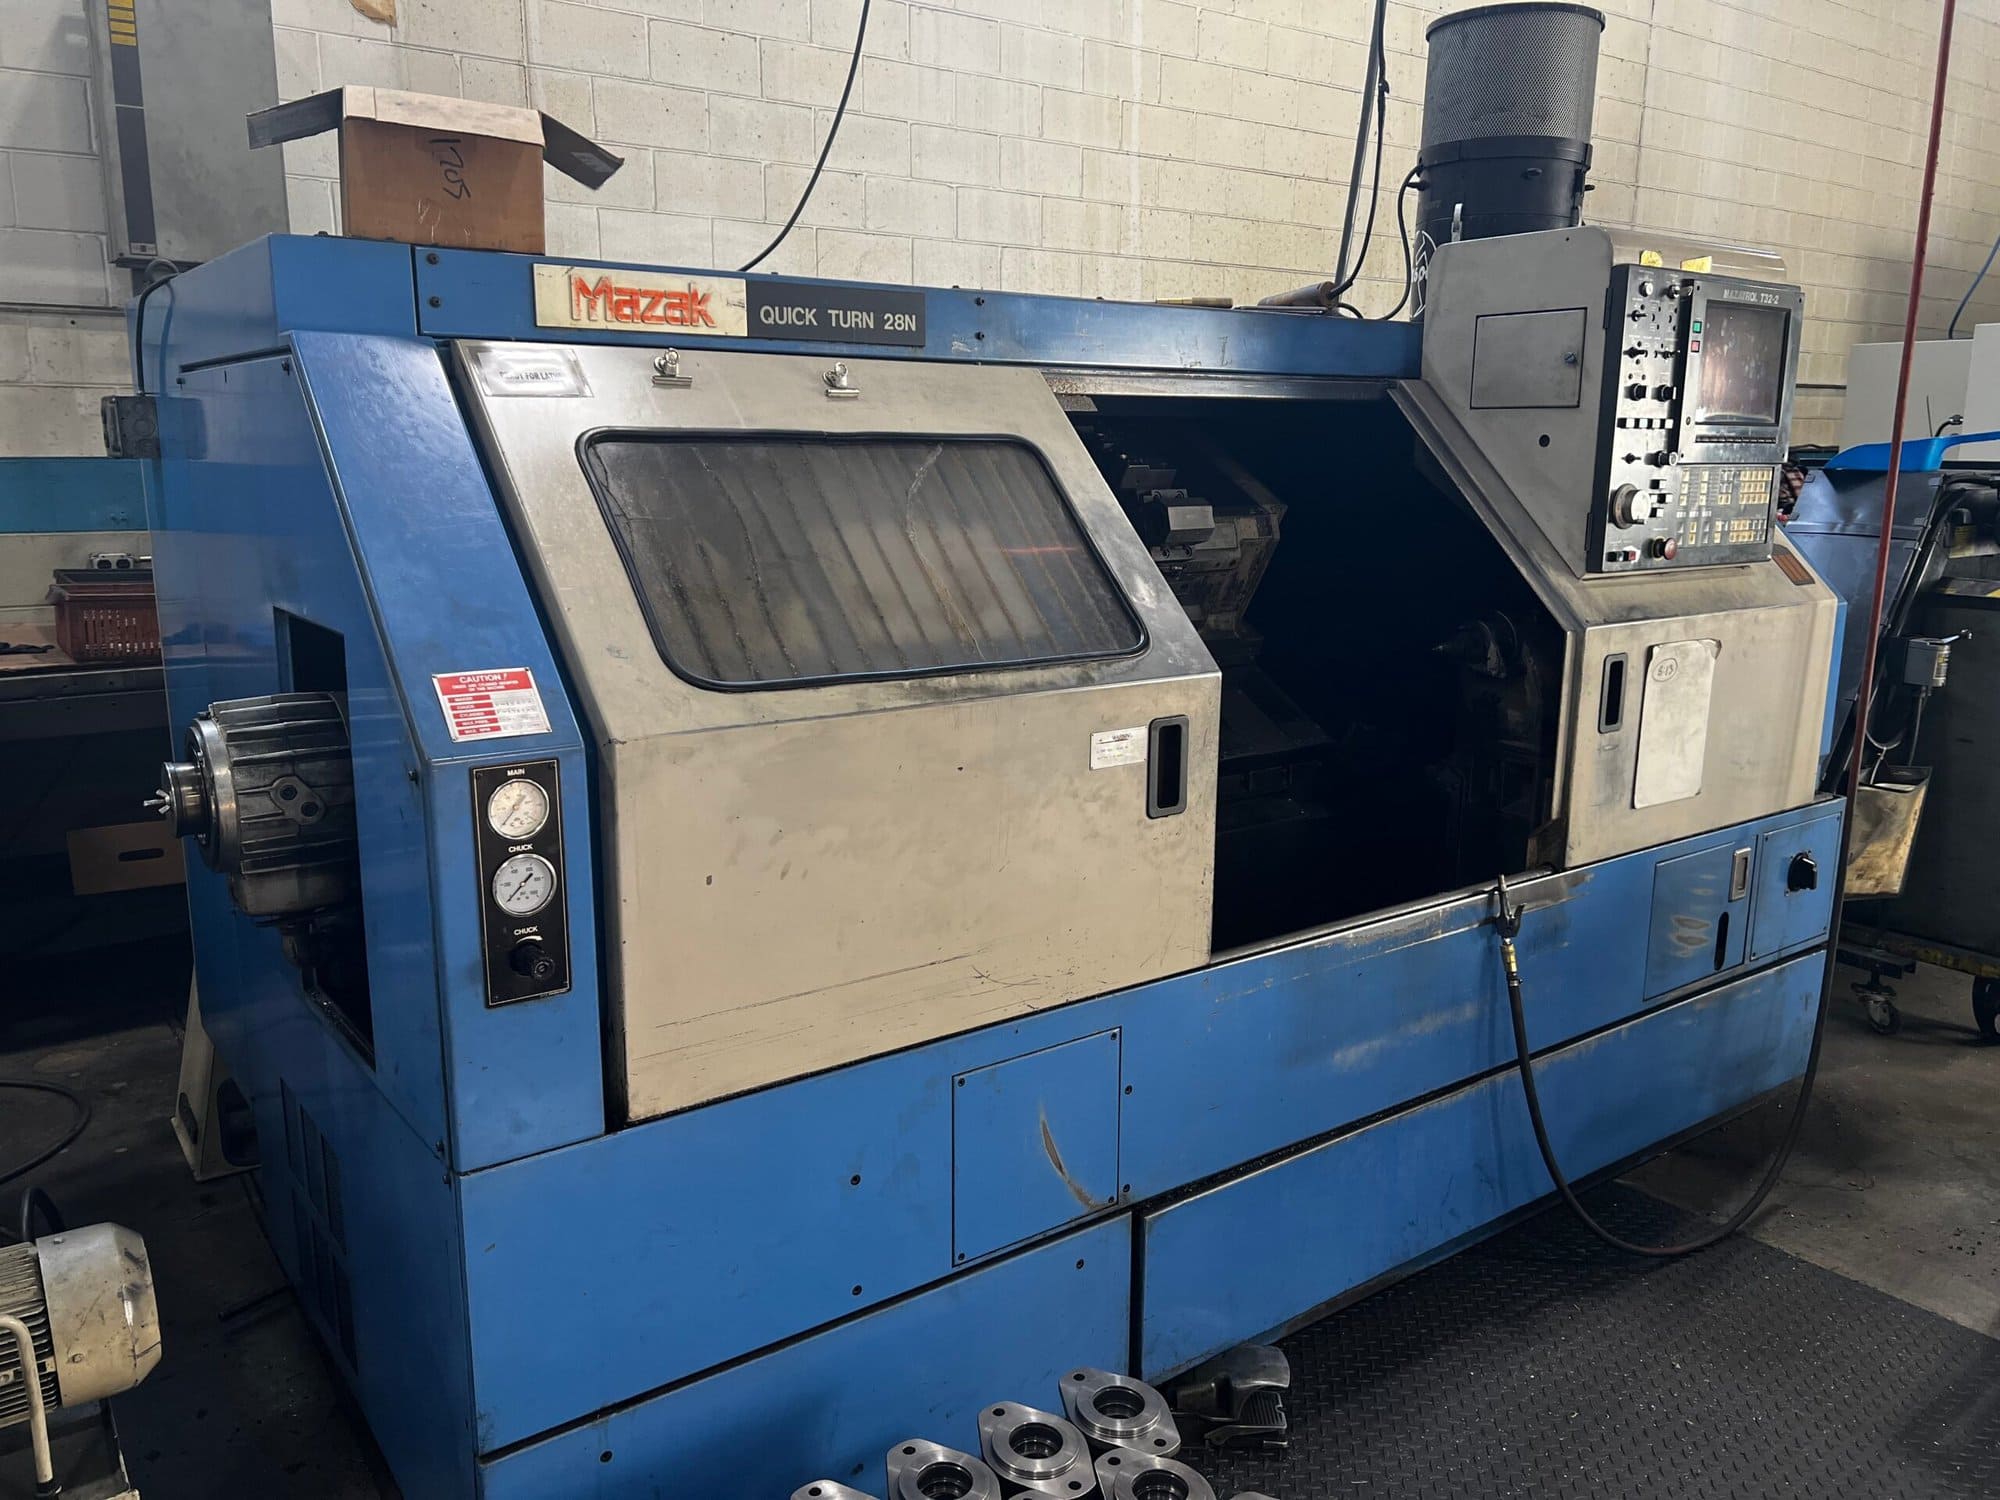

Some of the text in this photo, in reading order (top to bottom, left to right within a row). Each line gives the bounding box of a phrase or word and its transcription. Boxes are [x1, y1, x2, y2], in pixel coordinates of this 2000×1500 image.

[571, 275, 717, 328] Mazak
[760, 305, 916, 332] QUICK TURN 28N
[459, 674, 501, 684] CAUTION
[507, 768, 525, 776] MAIN
[508, 844, 533, 853] CHUCK
[514, 928, 538, 936] CHUCK
